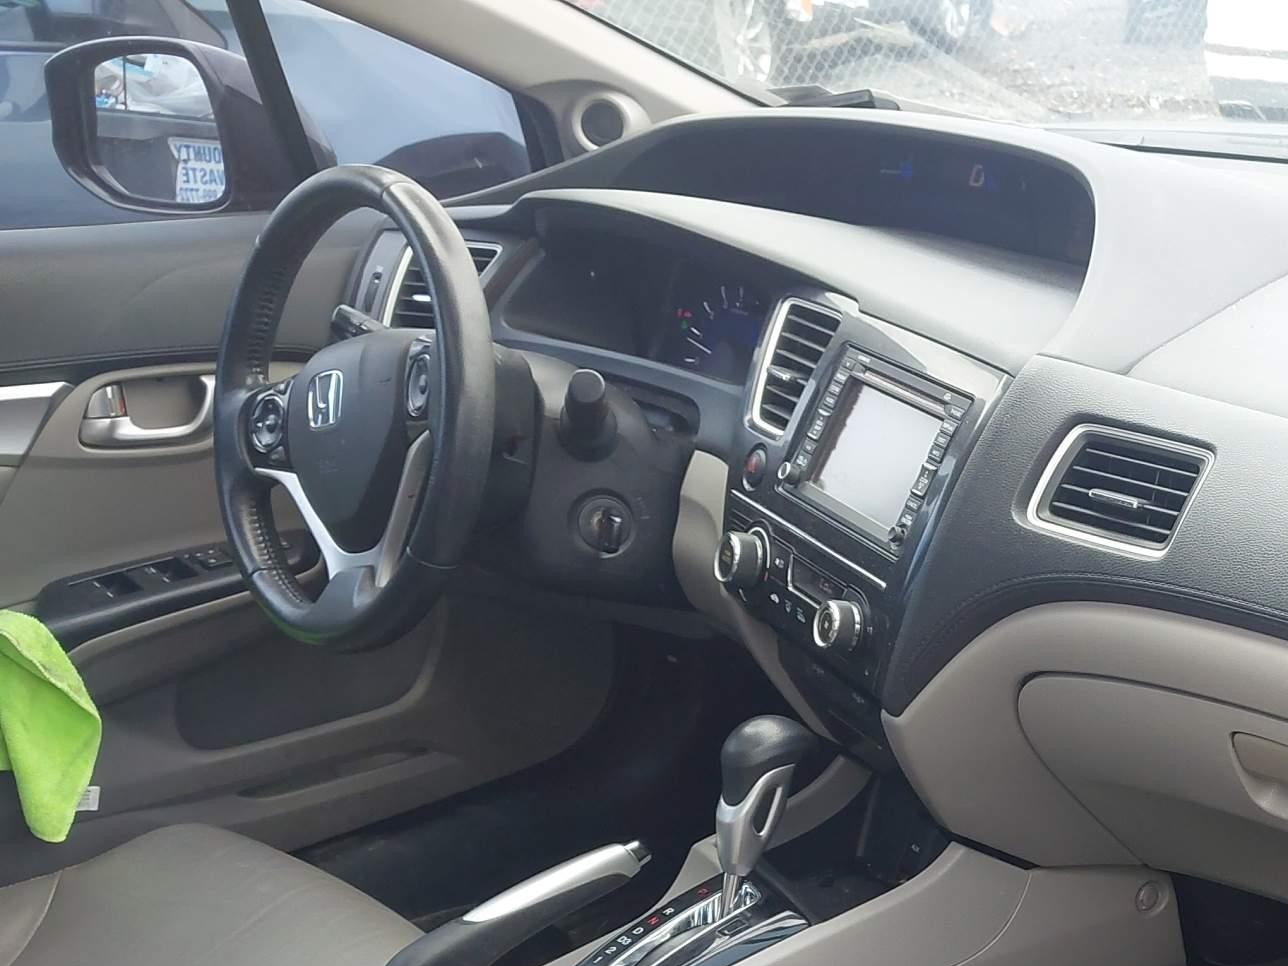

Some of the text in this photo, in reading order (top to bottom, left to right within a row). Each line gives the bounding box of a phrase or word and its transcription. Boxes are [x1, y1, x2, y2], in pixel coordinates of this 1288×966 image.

[662, 907, 674, 915] R
[647, 915, 659, 925] N
[632, 927, 644, 935] D
[605, 946, 617, 955] 2
